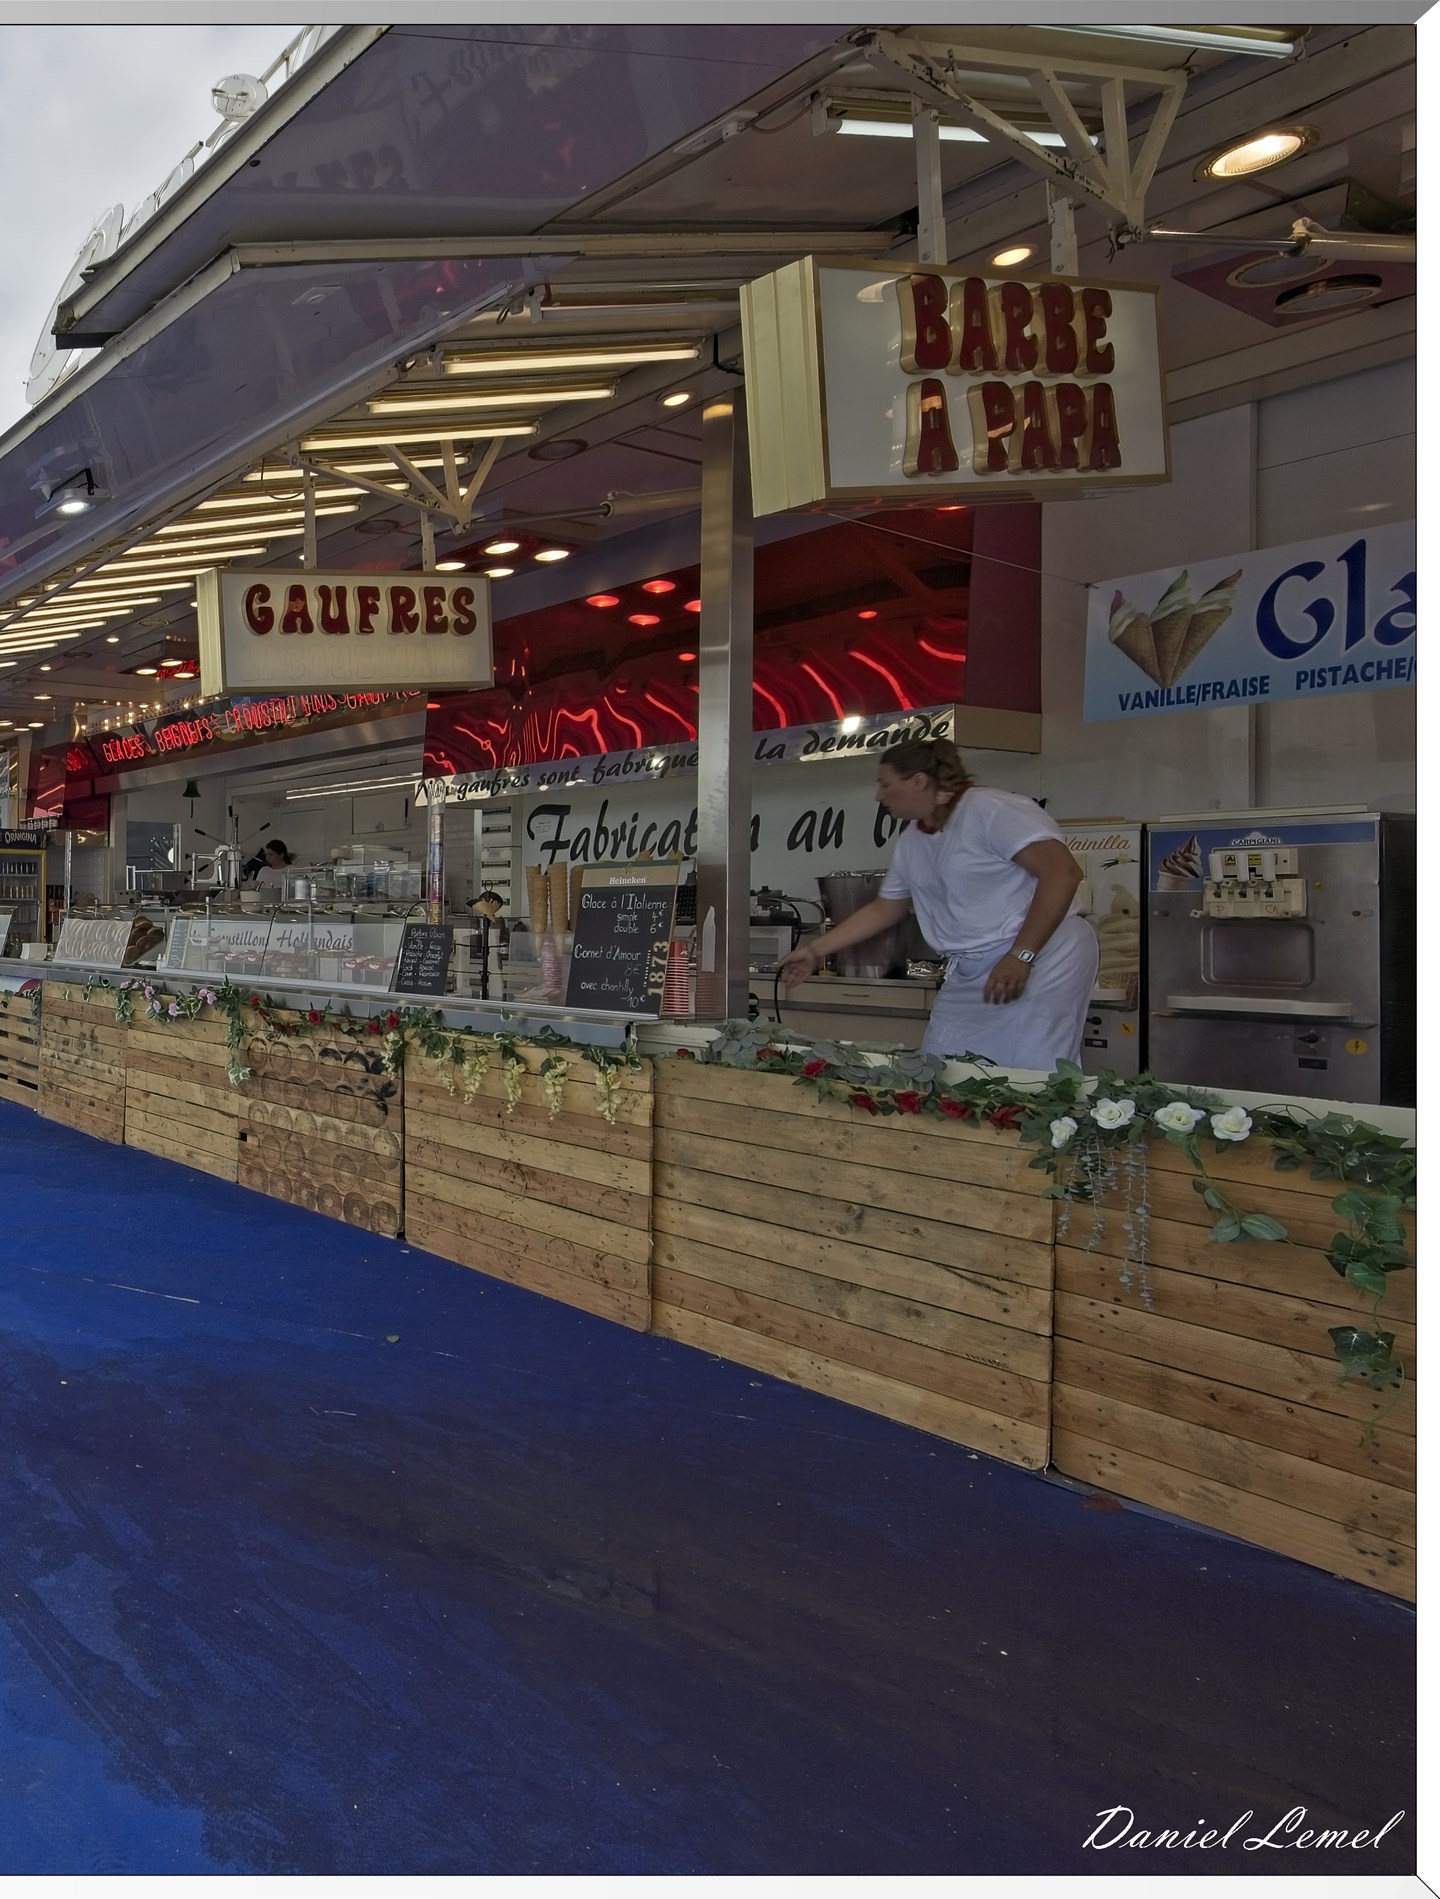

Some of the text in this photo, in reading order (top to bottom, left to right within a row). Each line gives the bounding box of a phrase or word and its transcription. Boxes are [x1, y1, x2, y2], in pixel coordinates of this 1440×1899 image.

[900, 274, 1115, 377] BARBE
[908, 378, 1122, 475] A PAPA
[244, 583, 477, 636] GAUFRES
[1118, 656, 1417, 711] VANILLE/FRAISE PISTACHE/
[155, 717, 213, 753] BEIGNETS
[457, 767, 531, 800] gaufres
[536, 771, 580, 788] sont
[754, 738, 786, 760] la
[803, 714, 950, 755] demande
[5, 831, 37, 844] ORANGINA
[527, 799, 760, 872] Fabricat
[787, 806, 845, 852] au
[609, 877, 647, 885] Heineken
[581, 894, 606, 909] Glace
[611, 897, 617, 909] à
[617, 911, 639, 923] simple
[614, 922, 640, 933] double
[574, 944, 641, 960] Cornet d'Amour
[647, 940, 669, 996] 1873
[581, 977, 633, 997] avec chantilly
